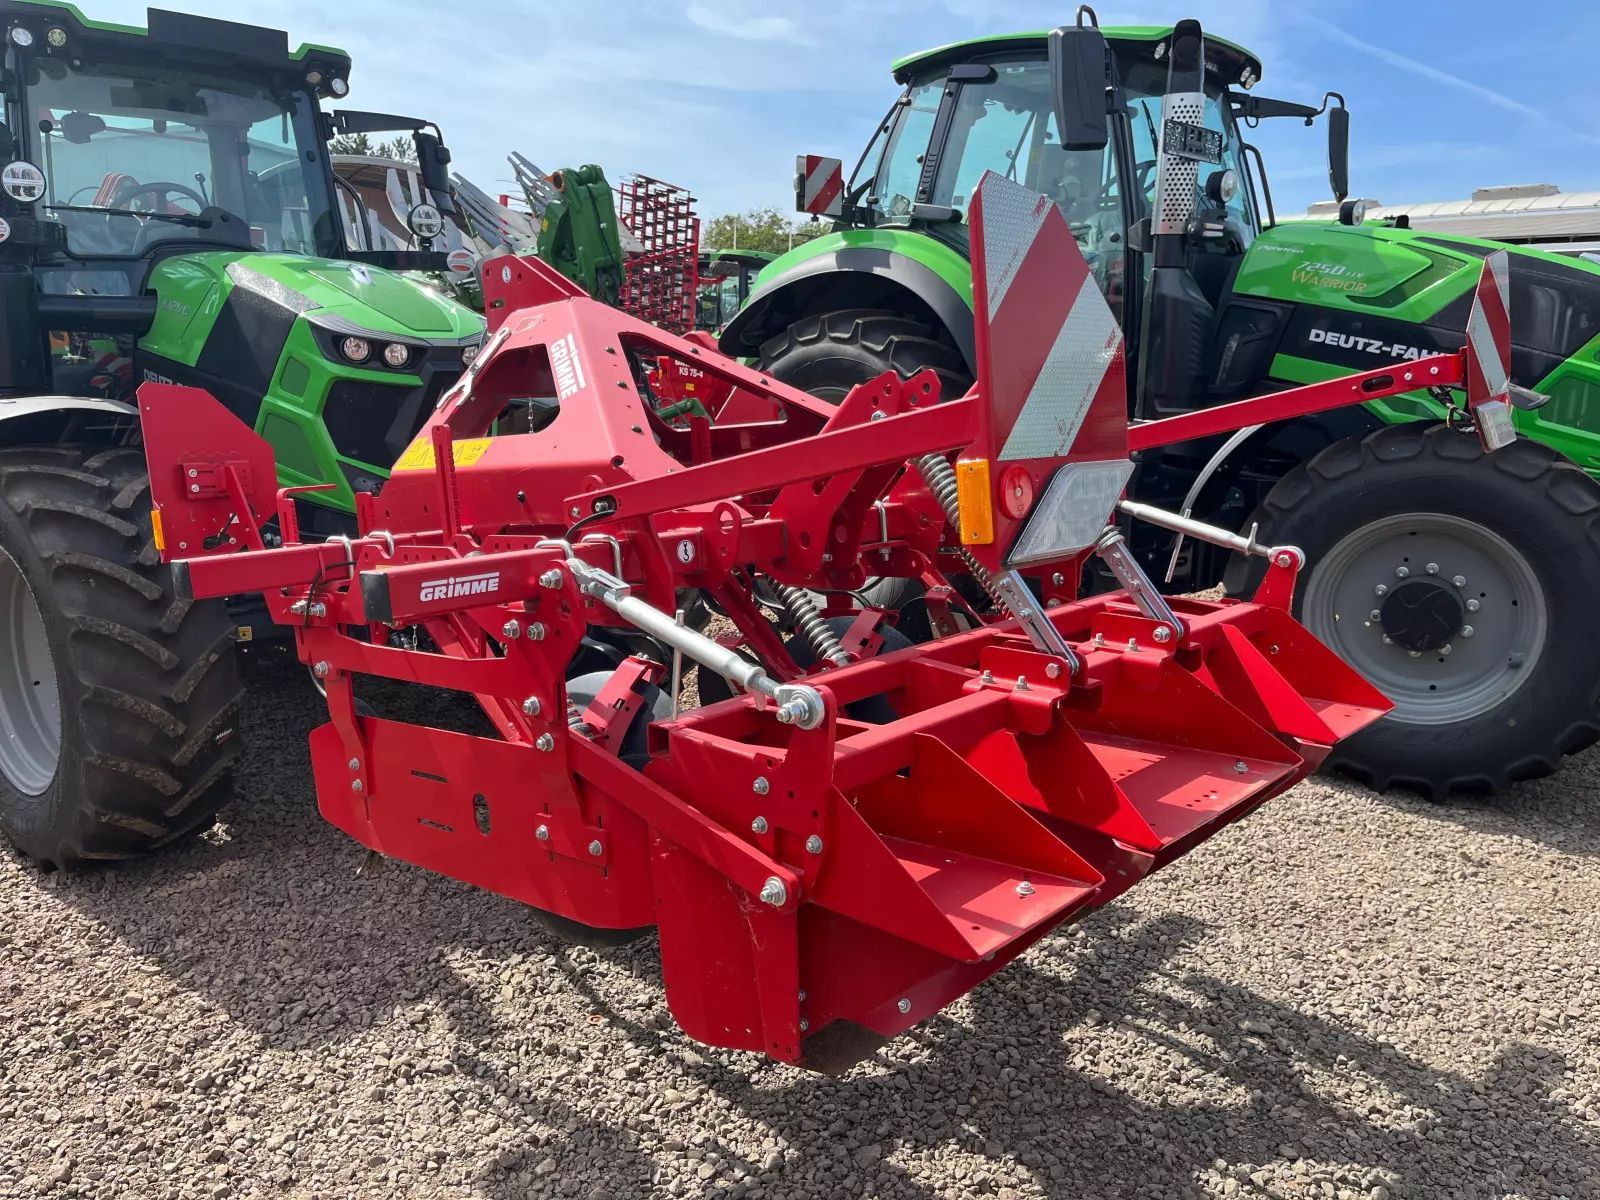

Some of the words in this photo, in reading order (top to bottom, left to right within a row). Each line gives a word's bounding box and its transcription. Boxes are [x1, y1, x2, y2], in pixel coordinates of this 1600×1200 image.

[1296, 261, 1347, 276] 7250
[1308, 328, 1448, 361] DEUTZ-FAH
[679, 367, 689, 376] KS
